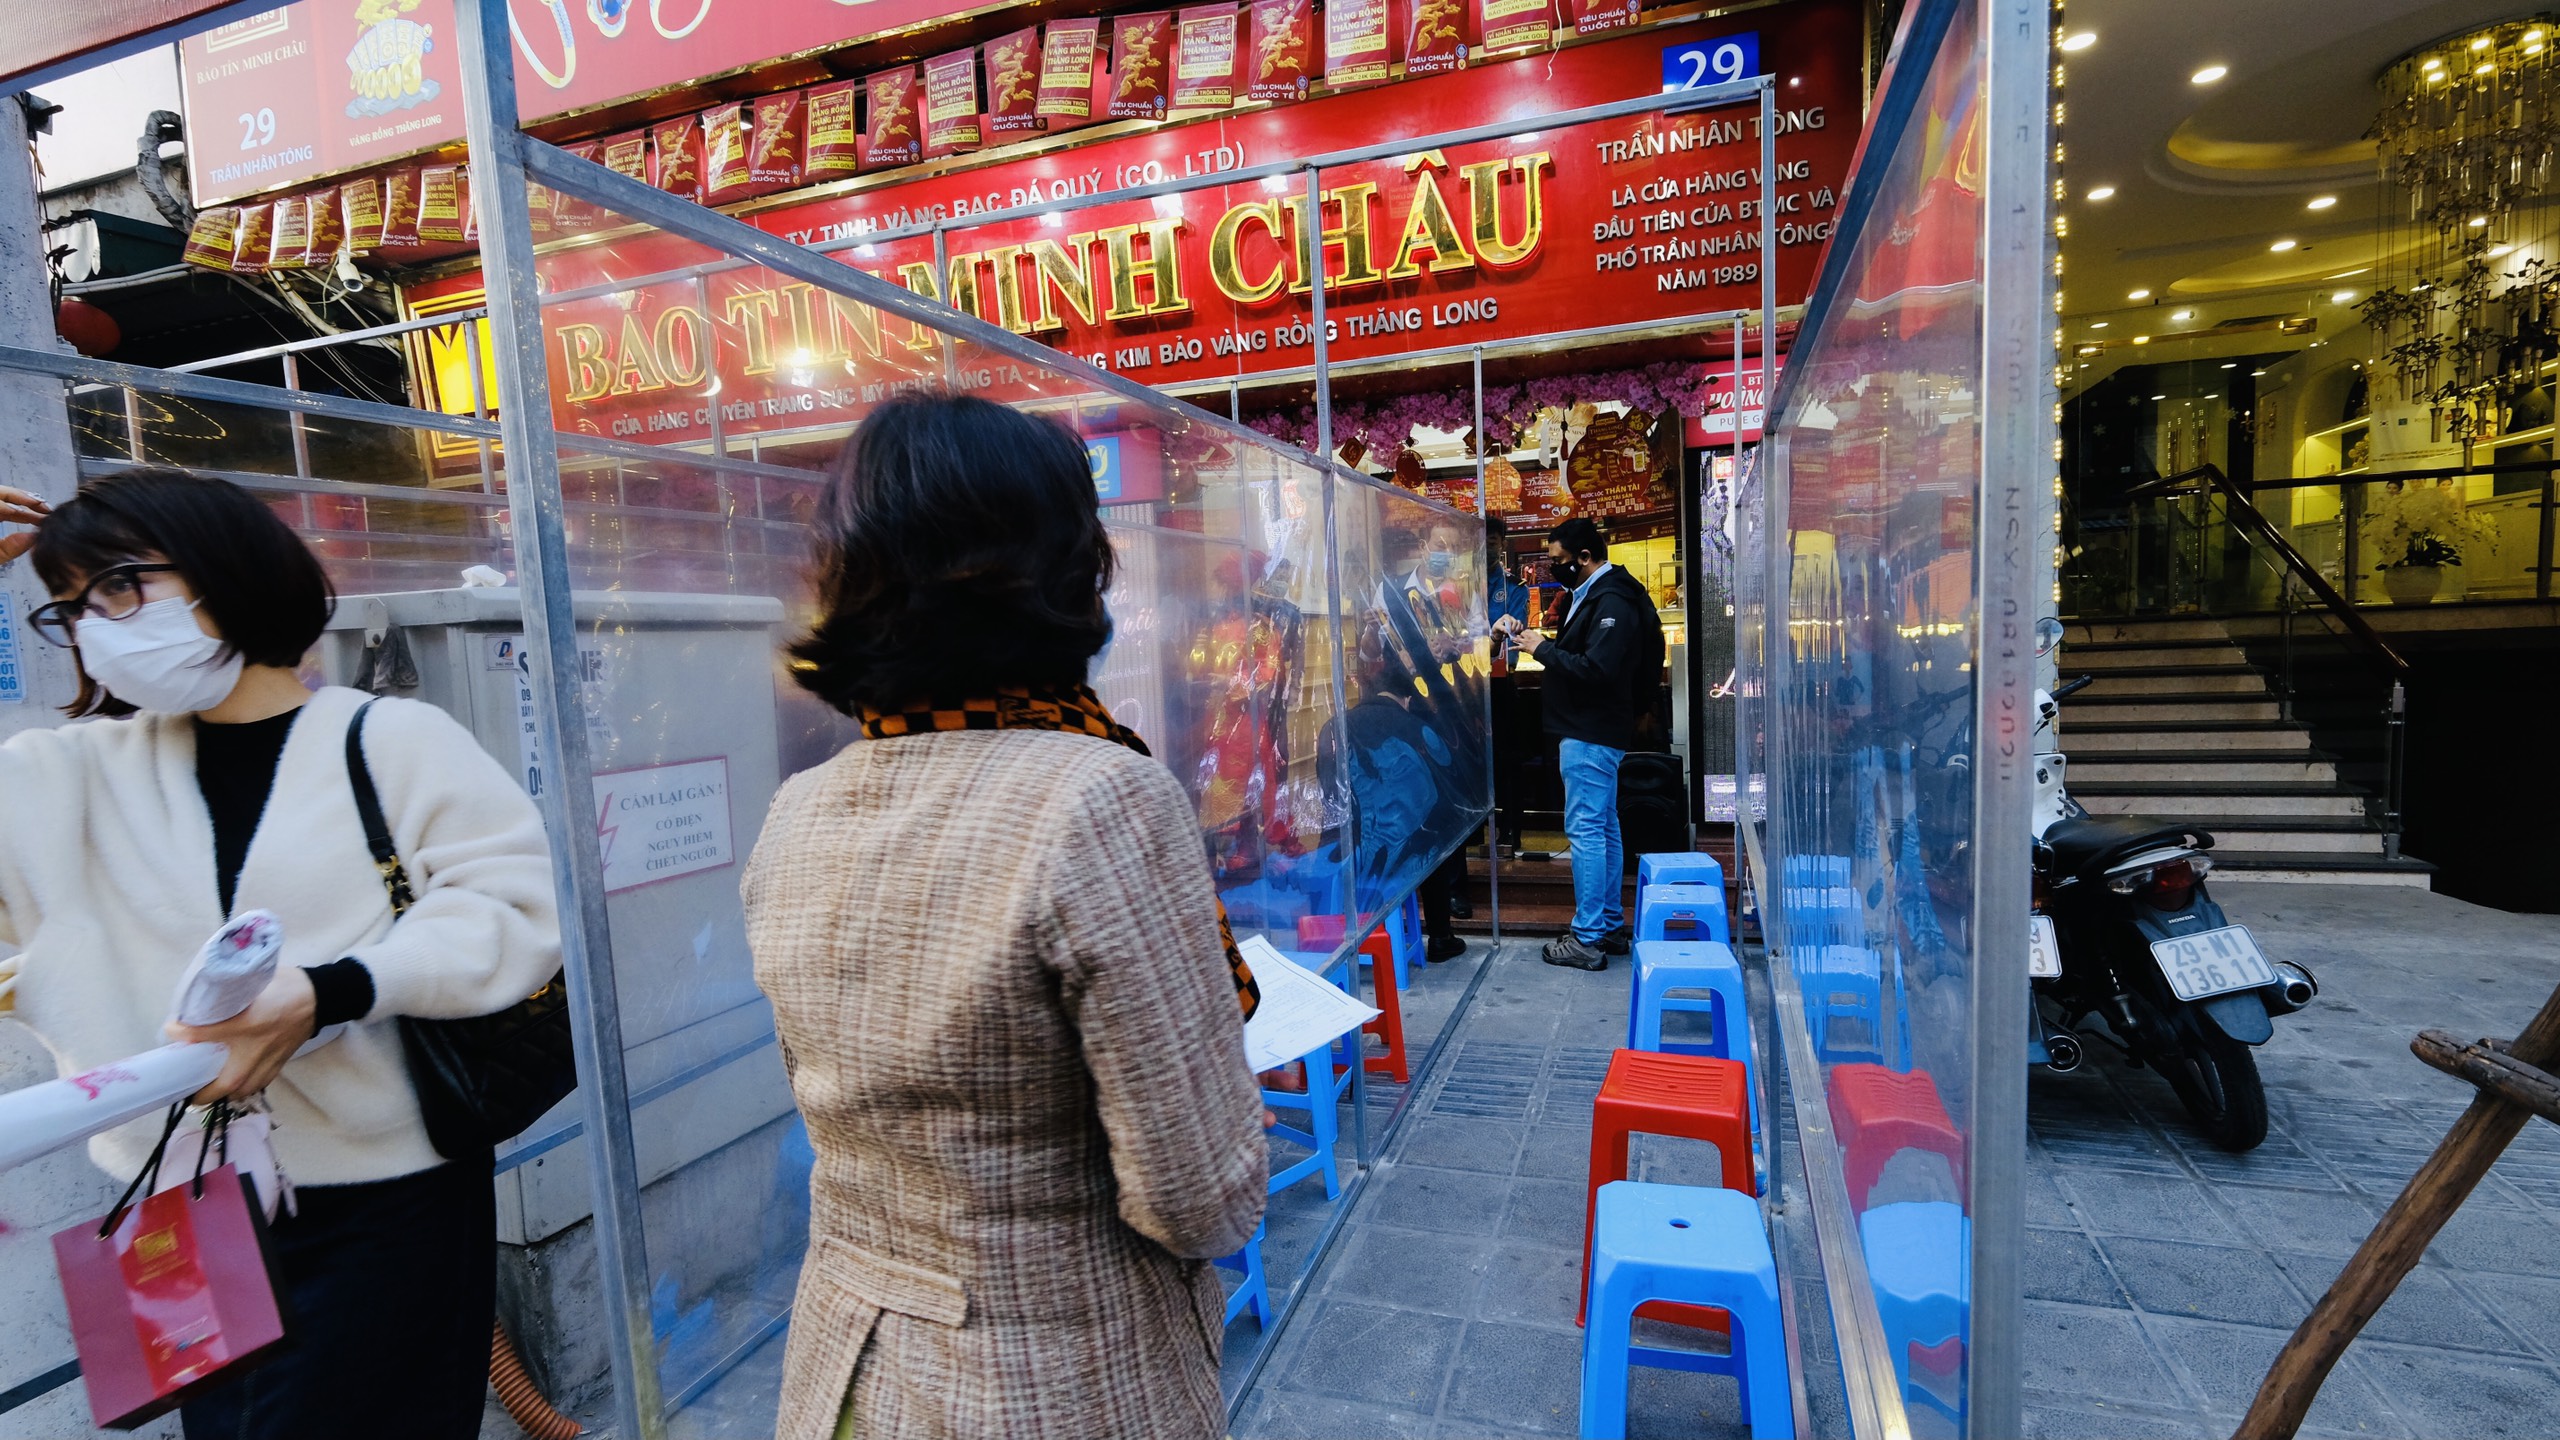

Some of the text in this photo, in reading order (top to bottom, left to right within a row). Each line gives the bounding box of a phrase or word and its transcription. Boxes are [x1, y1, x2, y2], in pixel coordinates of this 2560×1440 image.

[1332, 6, 1384, 23] VÀNG RỒNG
[1502, 1, 1532, 14] TOÀN GIÁ
[1579, 8, 1626, 24] TIÊU CHUẨN
[1331, 16, 1384, 33] THĂNG LONG
[1355, 26, 1377, 38] BTMC
[1494, 23, 1546, 38] NHẪN TRÒN TRƠN
[1580, 16, 1626, 33] QUỐC TẾ
[1184, 32, 1232, 46] VÀNG RỒNG
[1531, 32, 1548, 40] GOLD
[243, 50, 272, 72] MINH
[274, 40, 307, 61] CHÂU
[1048, 44, 1091, 56] VÀNG RỒNG
[1183, 43, 1232, 55] THĂNG LONG
[1047, 55, 1090, 65] THĂNG LONG
[1409, 52, 1455, 64] TIÊU CHUẨN
[1352, 63, 1384, 73] TRÒN TRƠN
[1409, 60, 1455, 73] QUỐC TẾ
[1678, 43, 1745, 92] 29
[951, 75, 972, 87] RỒNG
[1269, 82, 1295, 91] CHUẨN
[930, 84, 972, 101] THĂNG LONG
[1251, 91, 1295, 99] QUỐC TẾ
[1110, 108, 1153, 117] QUỐC TẾ
[1127, 101, 1152, 109] CHUẨN
[833, 114, 851, 123] LONG
[992, 119, 1034, 131] QUỐC TẾ
[238, 106, 276, 150] 29
[349, 114, 442, 147] VÀNG RỒNG THĂNG LONG
[1597, 129, 1664, 165] TRẦN
[1669, 119, 1742, 154] NHÂN
[210, 144, 313, 185] TRẦN NHÂN TÔNG
[822, 218, 878, 242] TNHH
[883, 202, 947, 232] VÀNG
[1010, 178, 1045, 207] ĐÁ
[1051, 166, 1103, 198] QUÝ
[1184, 141, 1245, 178] LTD)
[1611, 183, 1637, 208] LÀ
[1641, 176, 1680, 202] CỬA
[1686, 169, 1747, 195] HÀNG
[1593, 215, 1634, 242] ĐẦU
[1641, 209, 1685, 235] TIÊN
[1691, 201, 1733, 226] CỦA
[1808, 186, 1836, 208] VÀ
[898, 216, 1190, 351] MINH
[1209, 149, 1550, 303] CHÂU
[1596, 243, 1637, 272] PHỐ
[1640, 236, 1696, 264] TRẦN
[1701, 229, 1762, 257] NHÂN
[1657, 262, 1758, 292] NĂM 1989
[648, 408, 690, 432] HÀNG
[759, 393, 813, 418] TRANG
[996, 364, 1023, 387] TA
[1114, 346, 1151, 369] KIM
[1159, 334, 1203, 365] BẢO
[1211, 328, 1267, 357] VÀNG
[1345, 307, 1422, 339] THĂNG
[1433, 297, 1498, 326] LONG
[1720, 415, 1748, 426] PUE
[659, 788, 682, 806] LẠI
[648, 838, 680, 853] NGUY
[2168, 914, 2196, 924] HONDA
[2167, 931, 2244, 967] 29-N1
[2176, 955, 2268, 995] 136.11
